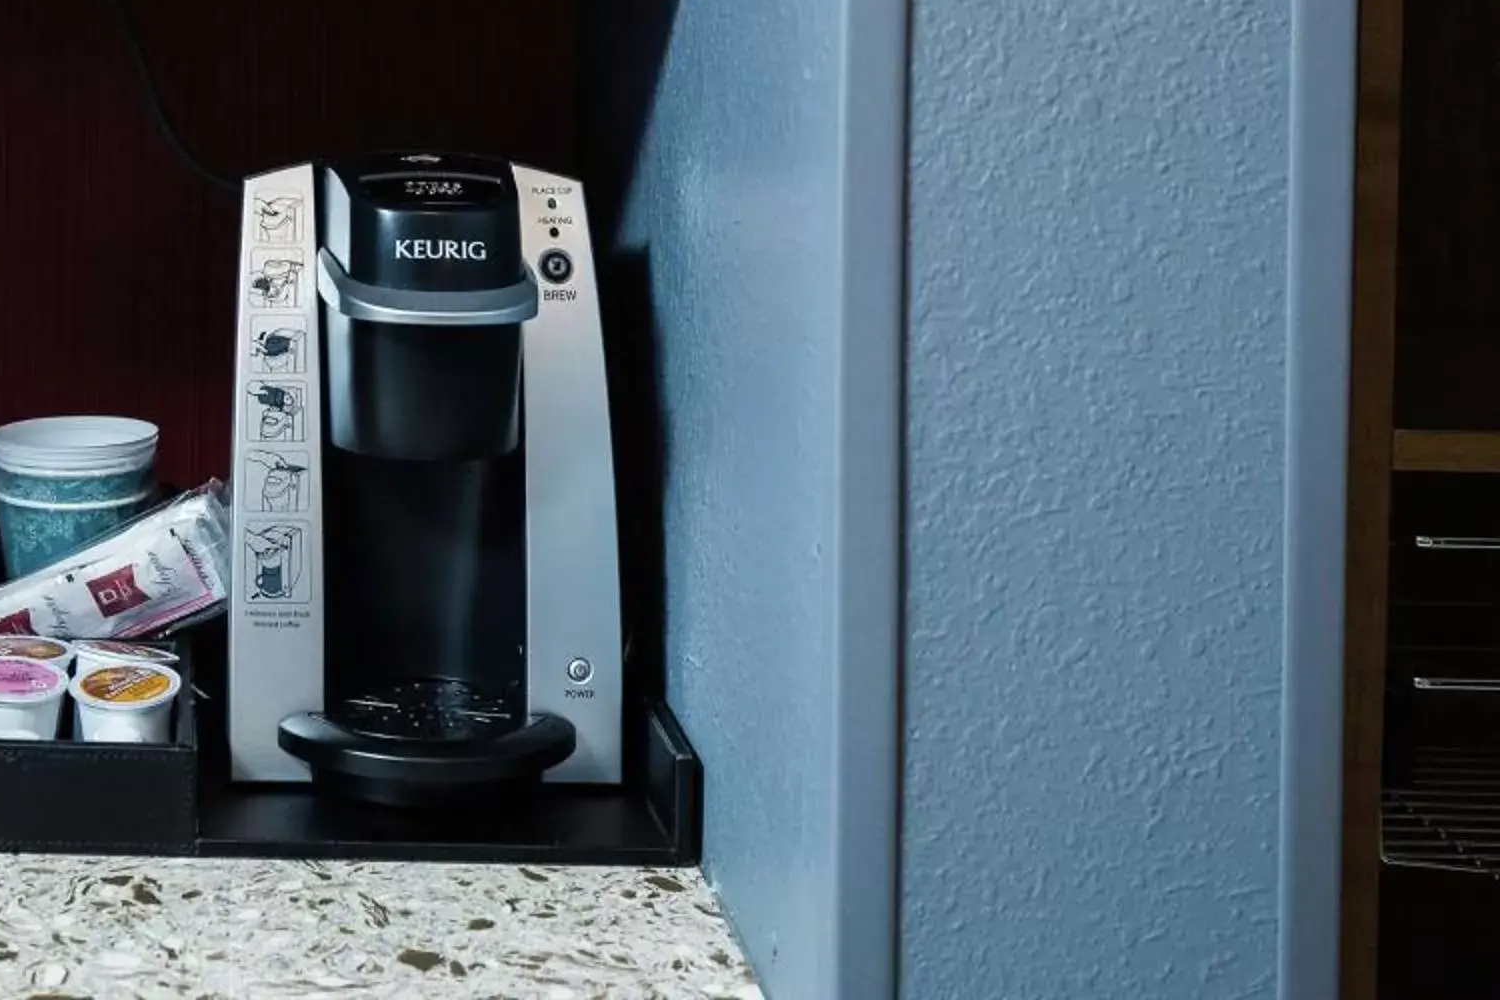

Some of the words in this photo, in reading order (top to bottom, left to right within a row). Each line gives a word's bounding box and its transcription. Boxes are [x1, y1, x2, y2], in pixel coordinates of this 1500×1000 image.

[395, 239, 487, 261] KEURIG
[543, 290, 577, 302] BREW
[564, 689, 595, 699] POWER
